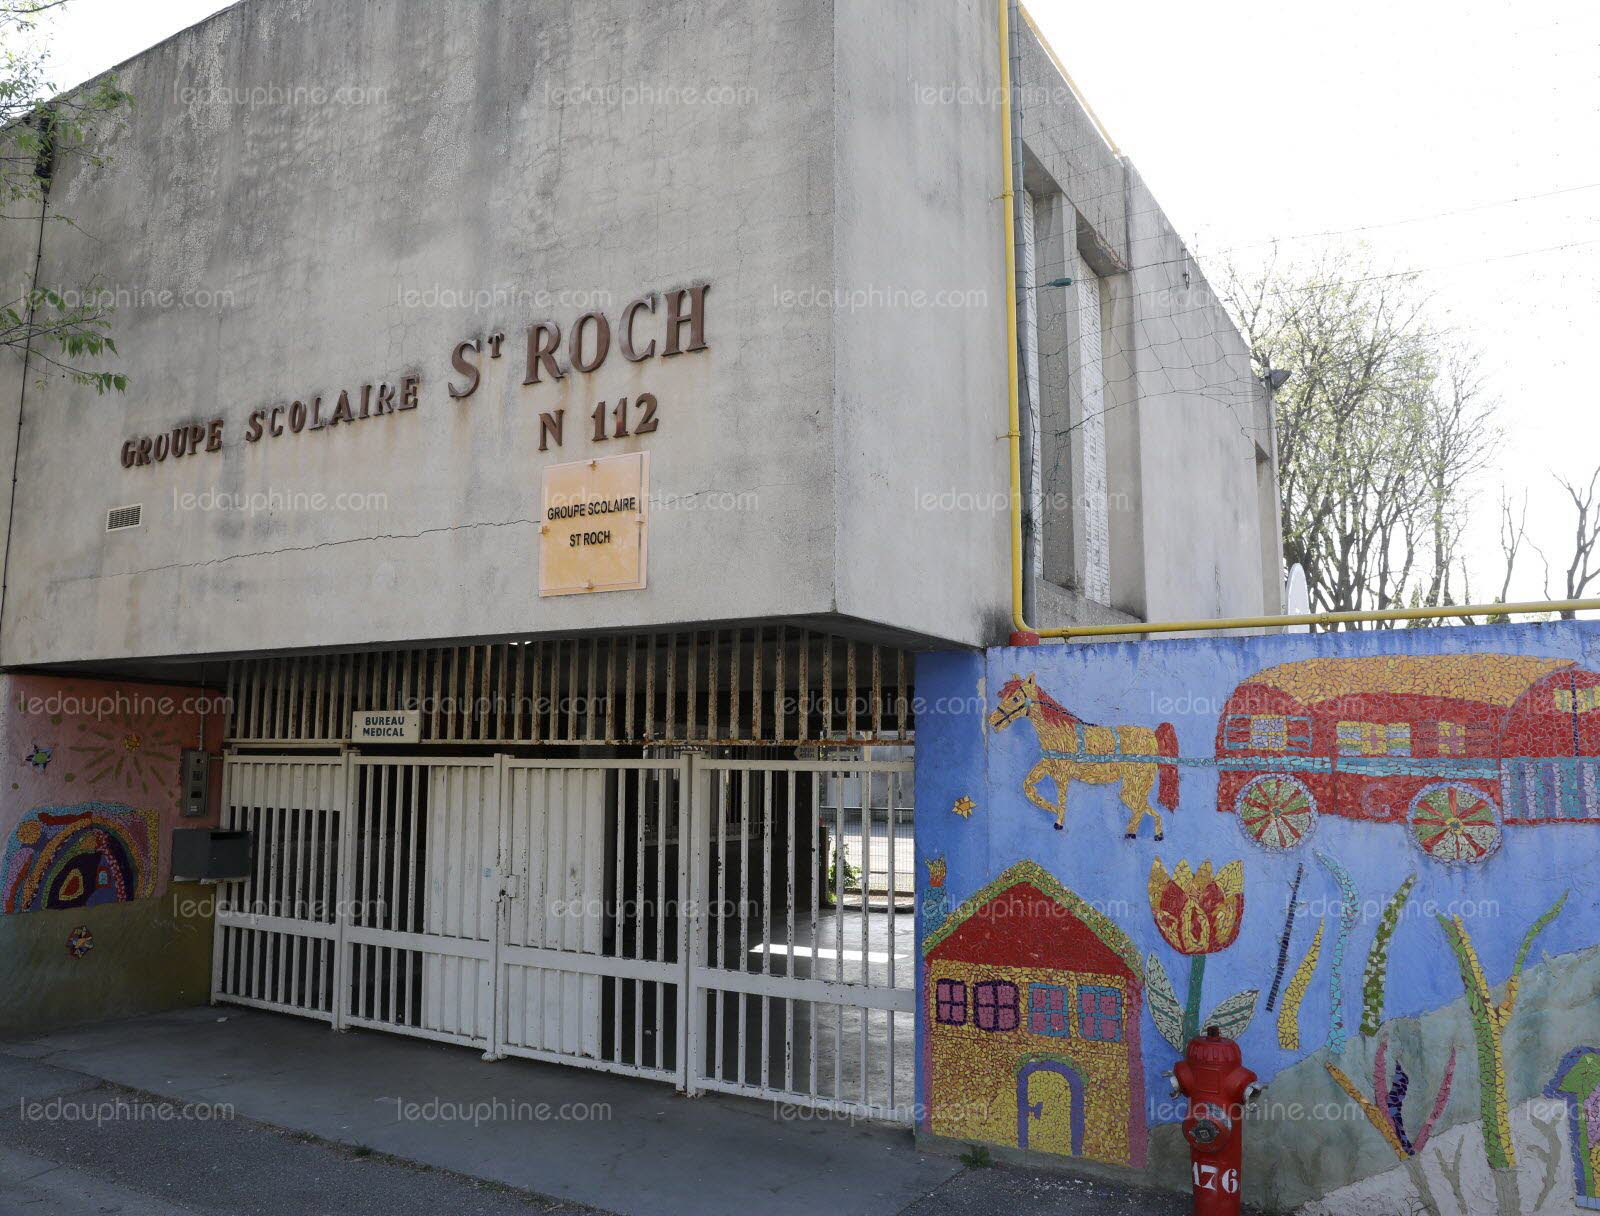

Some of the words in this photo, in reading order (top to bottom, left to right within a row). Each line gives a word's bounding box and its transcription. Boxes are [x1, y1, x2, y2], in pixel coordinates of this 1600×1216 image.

[121, 419, 224, 468] GROUPE
[245, 374, 421, 443] SCOLAIRE
[522, 284, 711, 386] ROCH
[591, 392, 659, 442] 112
[547, 503, 585, 520] GROUPE
[587, 497, 636, 515] SCOLAIRE
[569, 533, 581, 547] ST
[583, 530, 611, 546] ROCH
[362, 727, 405, 737] MEDICAL
[365, 716, 405, 726] BUREAU
[1192, 1161, 1239, 1194] 176
